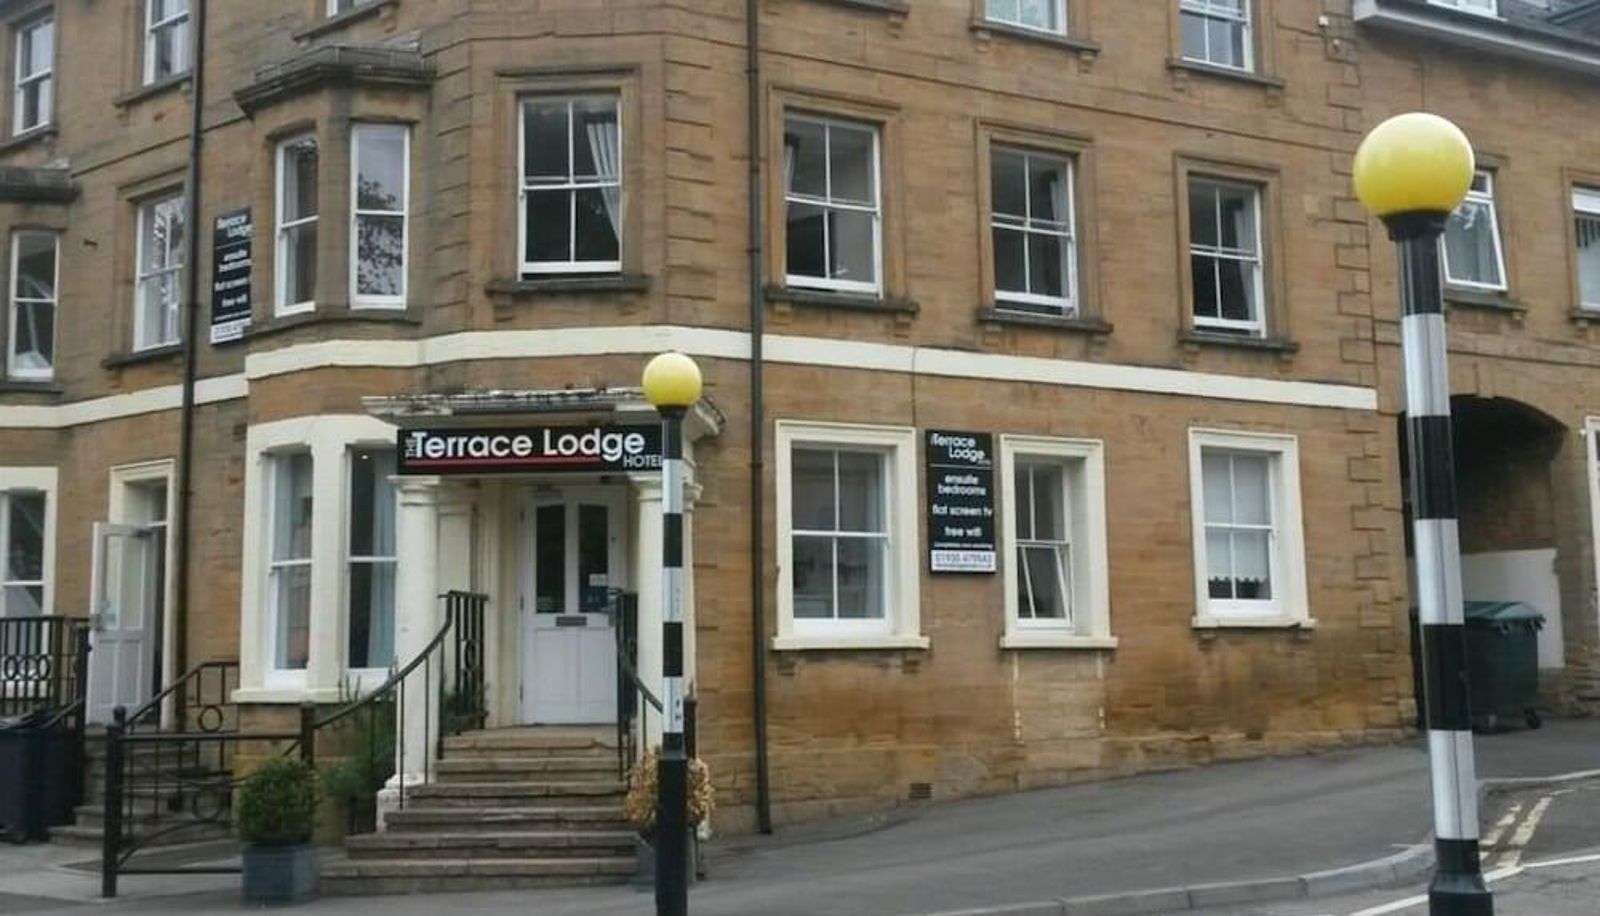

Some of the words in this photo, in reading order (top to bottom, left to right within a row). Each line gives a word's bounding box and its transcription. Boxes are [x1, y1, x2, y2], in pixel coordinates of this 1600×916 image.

[412, 432, 533, 458] Terrace
[543, 428, 645, 461] Lodge
[934, 432, 976, 448] Terrace
[949, 444, 985, 463] Lodge
[938, 483, 986, 496] bedrooms
[932, 504, 948, 515] flat
[949, 506, 982, 516] screen
[944, 526, 964, 537] free
